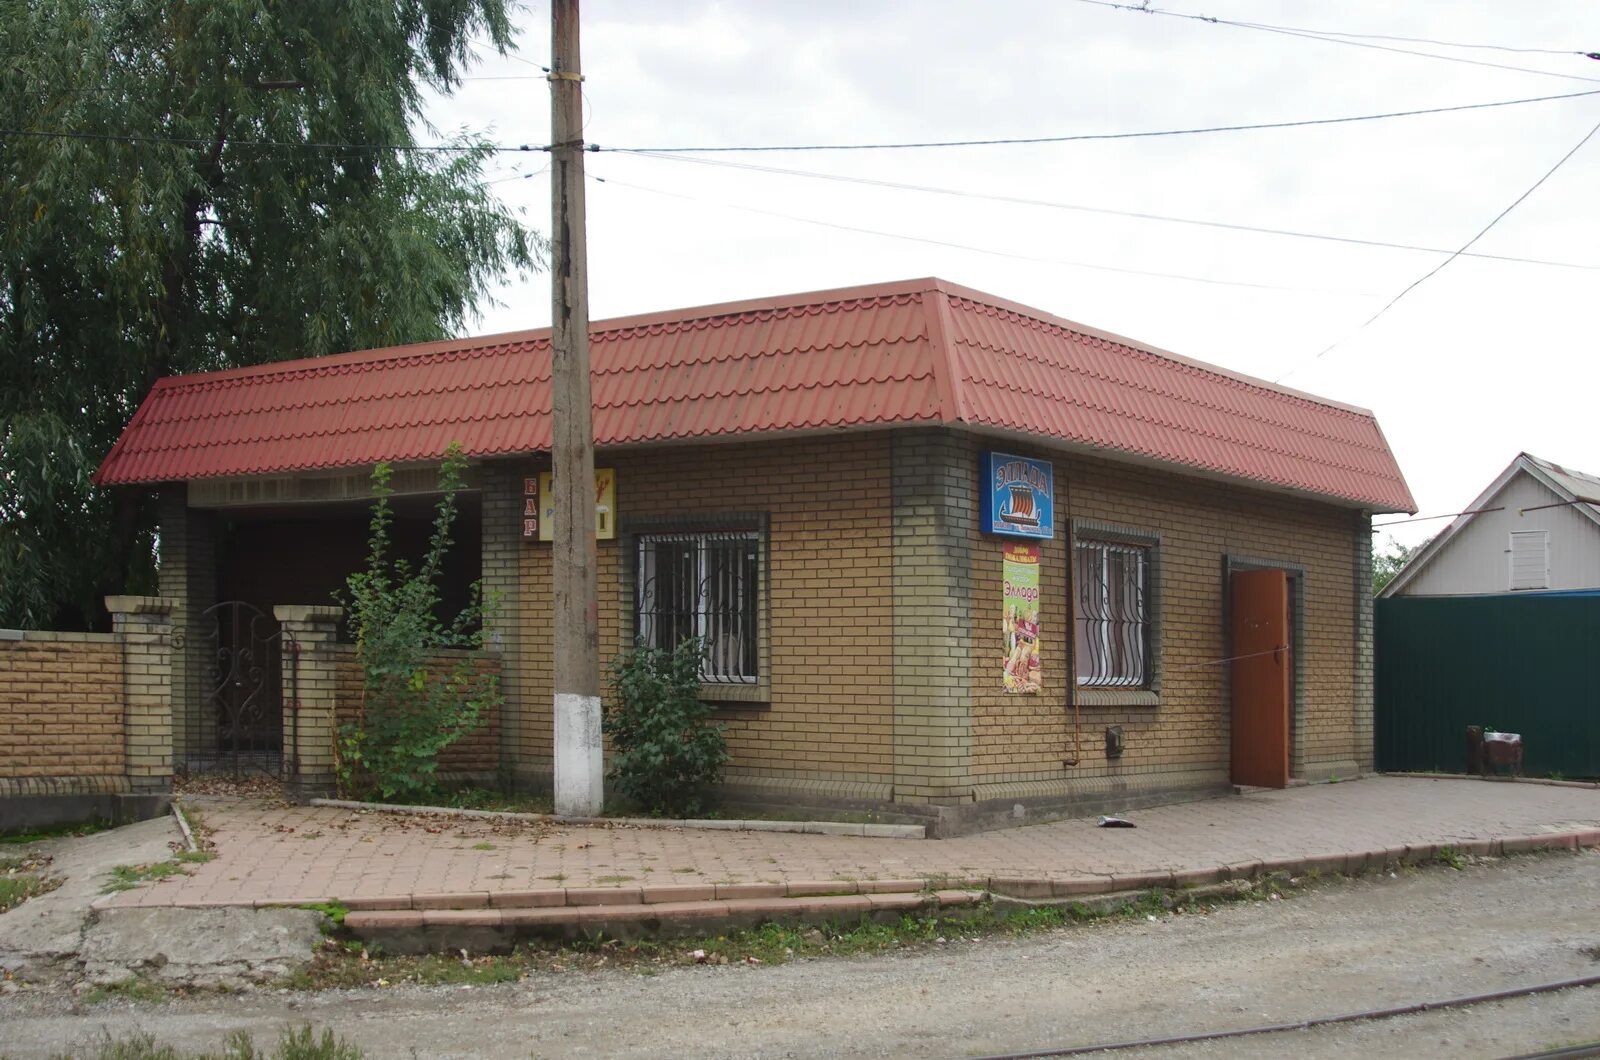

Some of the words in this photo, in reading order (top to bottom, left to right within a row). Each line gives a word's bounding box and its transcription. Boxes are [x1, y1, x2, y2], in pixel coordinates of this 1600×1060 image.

[996, 461, 1049, 498] ЭЛЛАДА
[523, 478, 537, 536] БАР
[1004, 581, 1038, 602] Эллада
